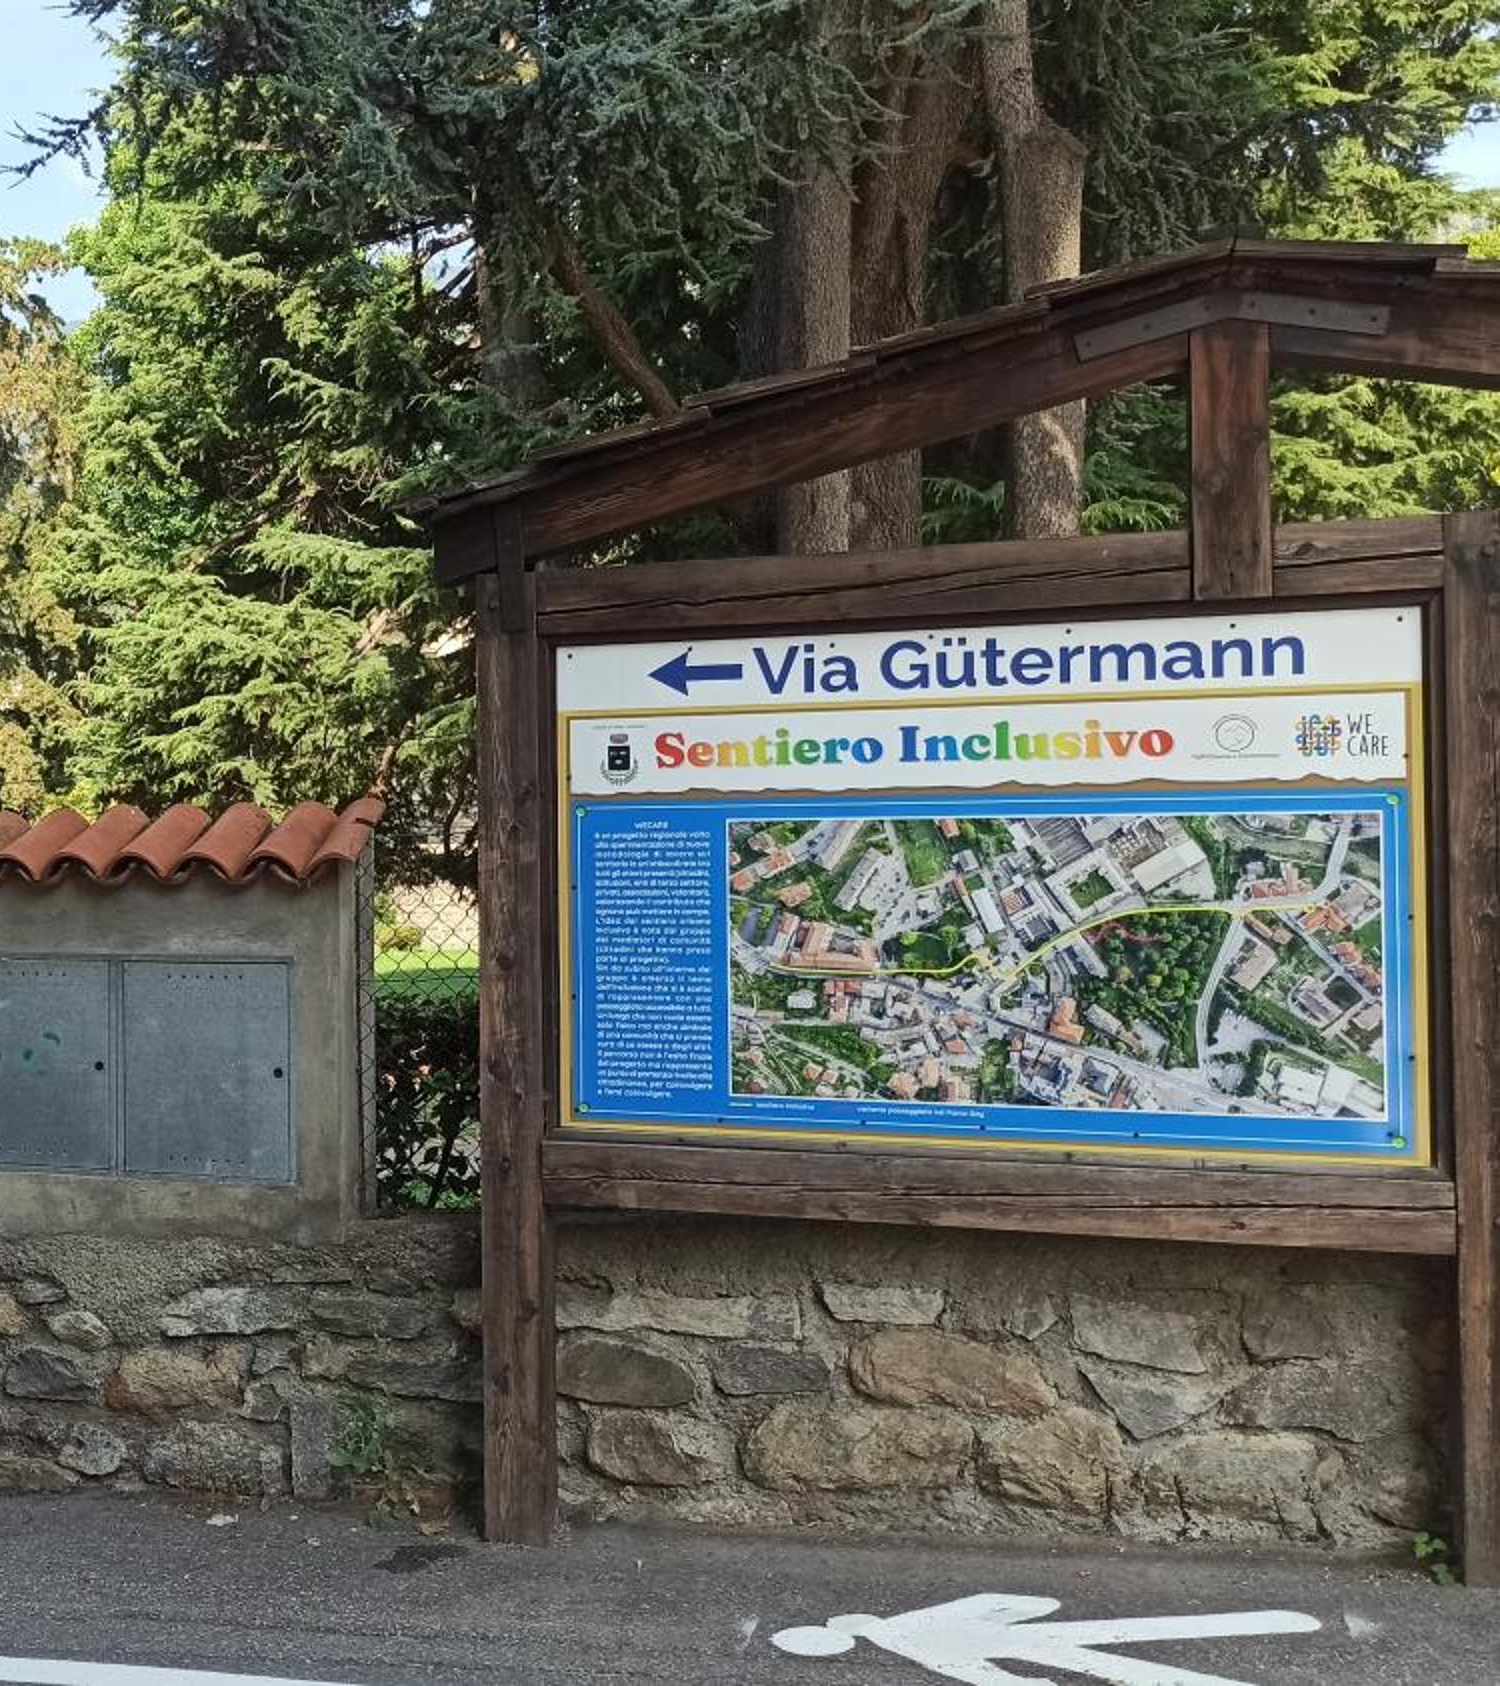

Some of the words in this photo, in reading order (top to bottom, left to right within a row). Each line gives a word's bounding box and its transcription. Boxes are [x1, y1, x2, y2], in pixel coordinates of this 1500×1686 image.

[752, 644, 859, 695] Via
[880, 635, 1305, 690] Gütermann
[1347, 713, 1373, 735] WE
[653, 729, 884, 769] Sentiero
[899, 720, 1175, 764] Inclusivo
[1347, 735, 1389, 757] CARE
